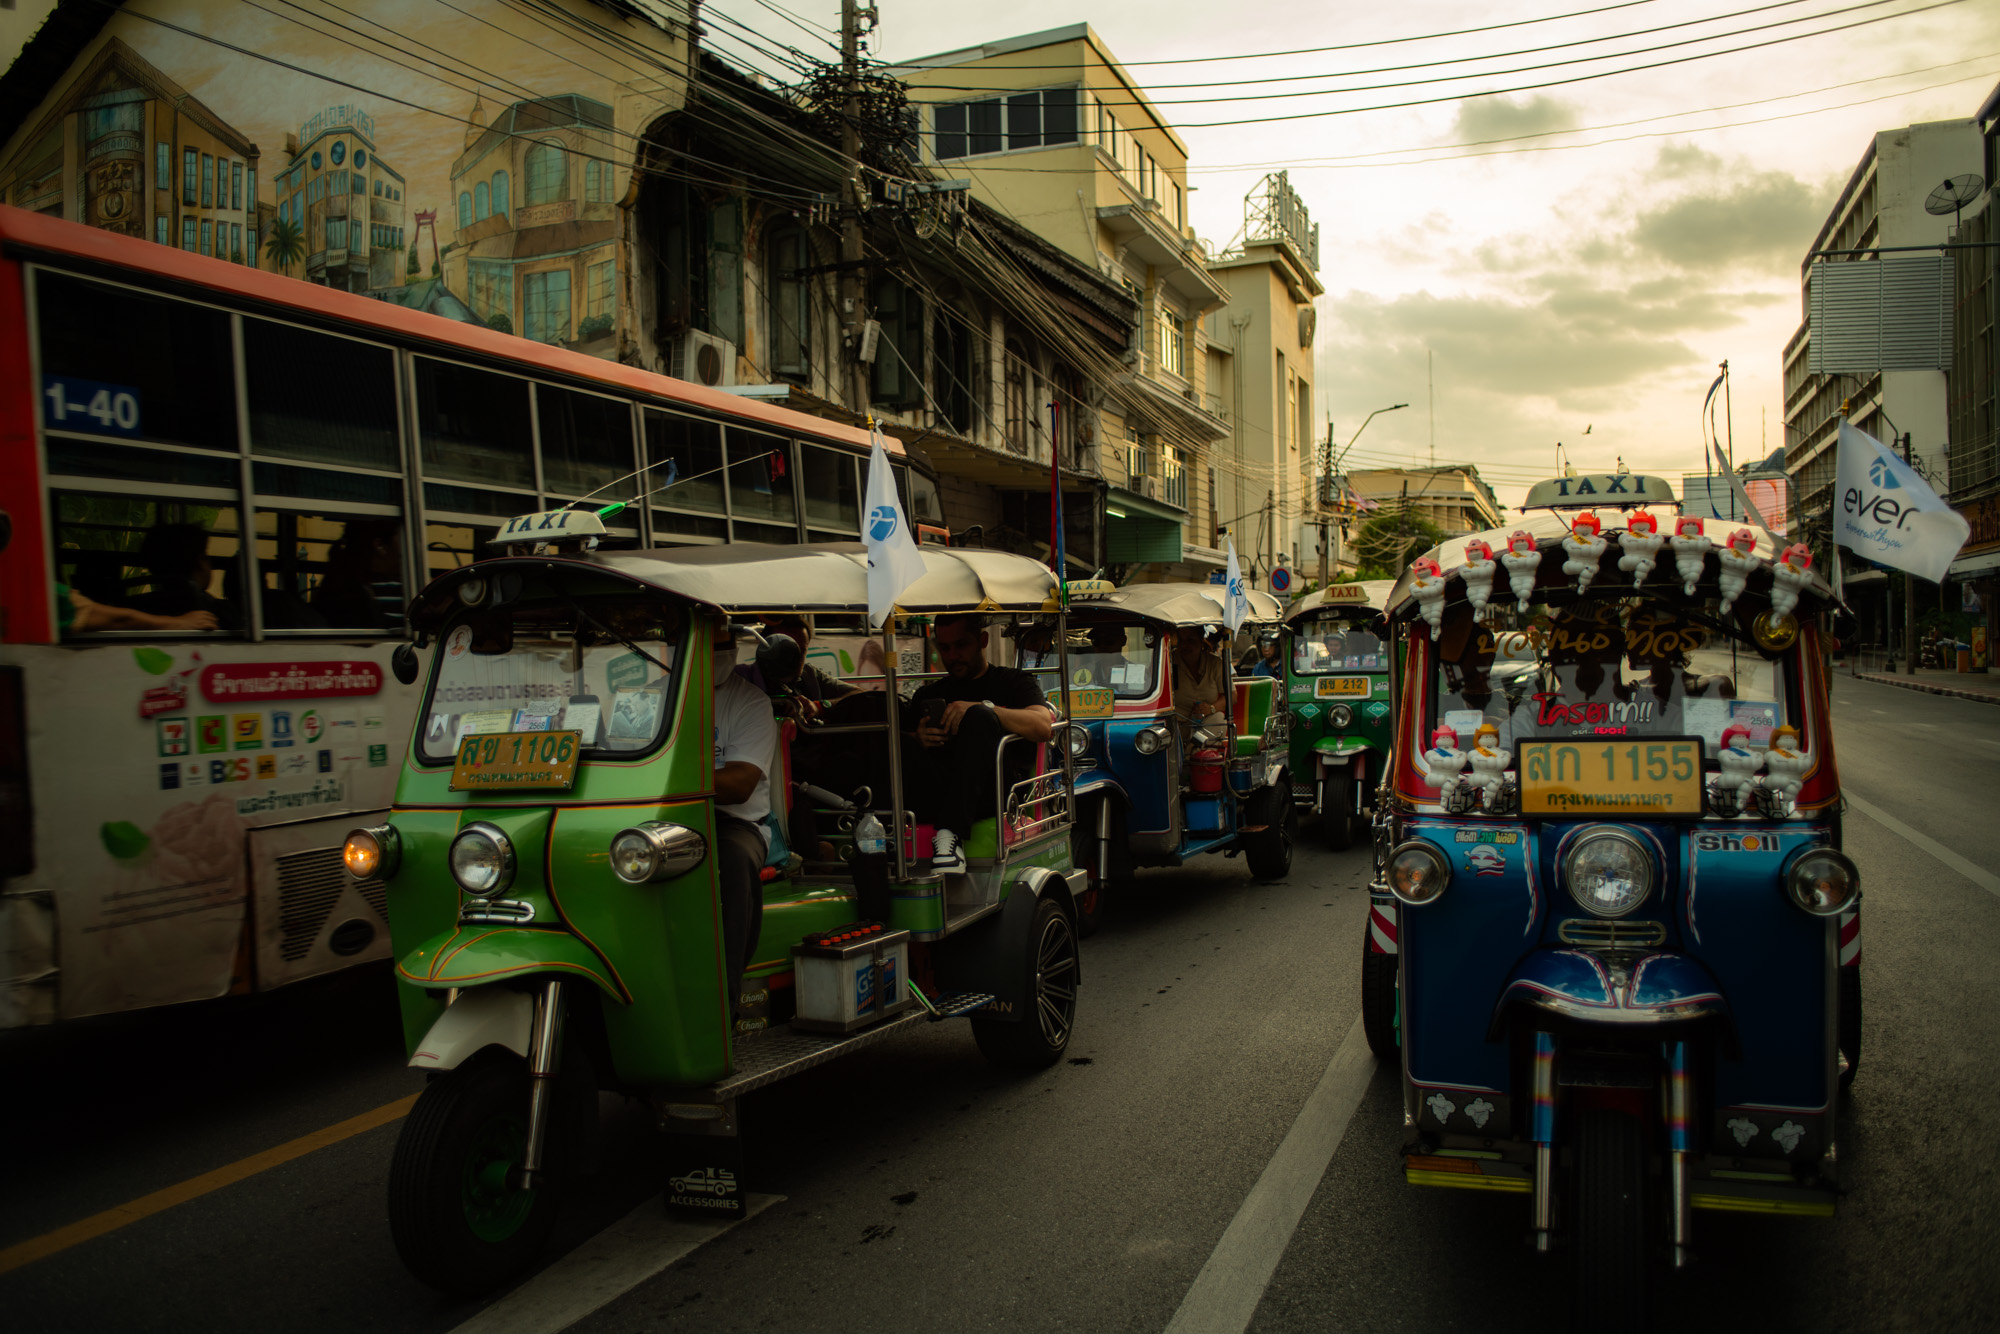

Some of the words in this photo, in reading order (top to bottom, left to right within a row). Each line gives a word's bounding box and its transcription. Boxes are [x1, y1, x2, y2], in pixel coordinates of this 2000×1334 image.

[45, 382, 140, 430] 1-40
[1553, 475, 1646, 496] TAXI
[507, 512, 571, 533] TAXI
[1068, 581, 1102, 591] TAXI
[1331, 587, 1358, 598] TAXI
[1342, 678, 1363, 689] 212
[1078, 691, 1111, 706] 1073
[529, 721, 546, 730] 2568
[1751, 716, 1773, 727] 2569
[462, 737, 500, 766] สข
[512, 735, 574, 763] 1106
[1527, 743, 1581, 781] สก
[1601, 745, 1694, 781] 1155
[211, 757, 251, 784] B2S
[1547, 793, 1673, 811] กรุงเทพมหานคร
[1698, 835, 1779, 851] Shll
[741, 993, 764, 1004] Chang
[741, 1021, 764, 1031] Chang
[670, 1194, 739, 1210] ACCESSORIES
